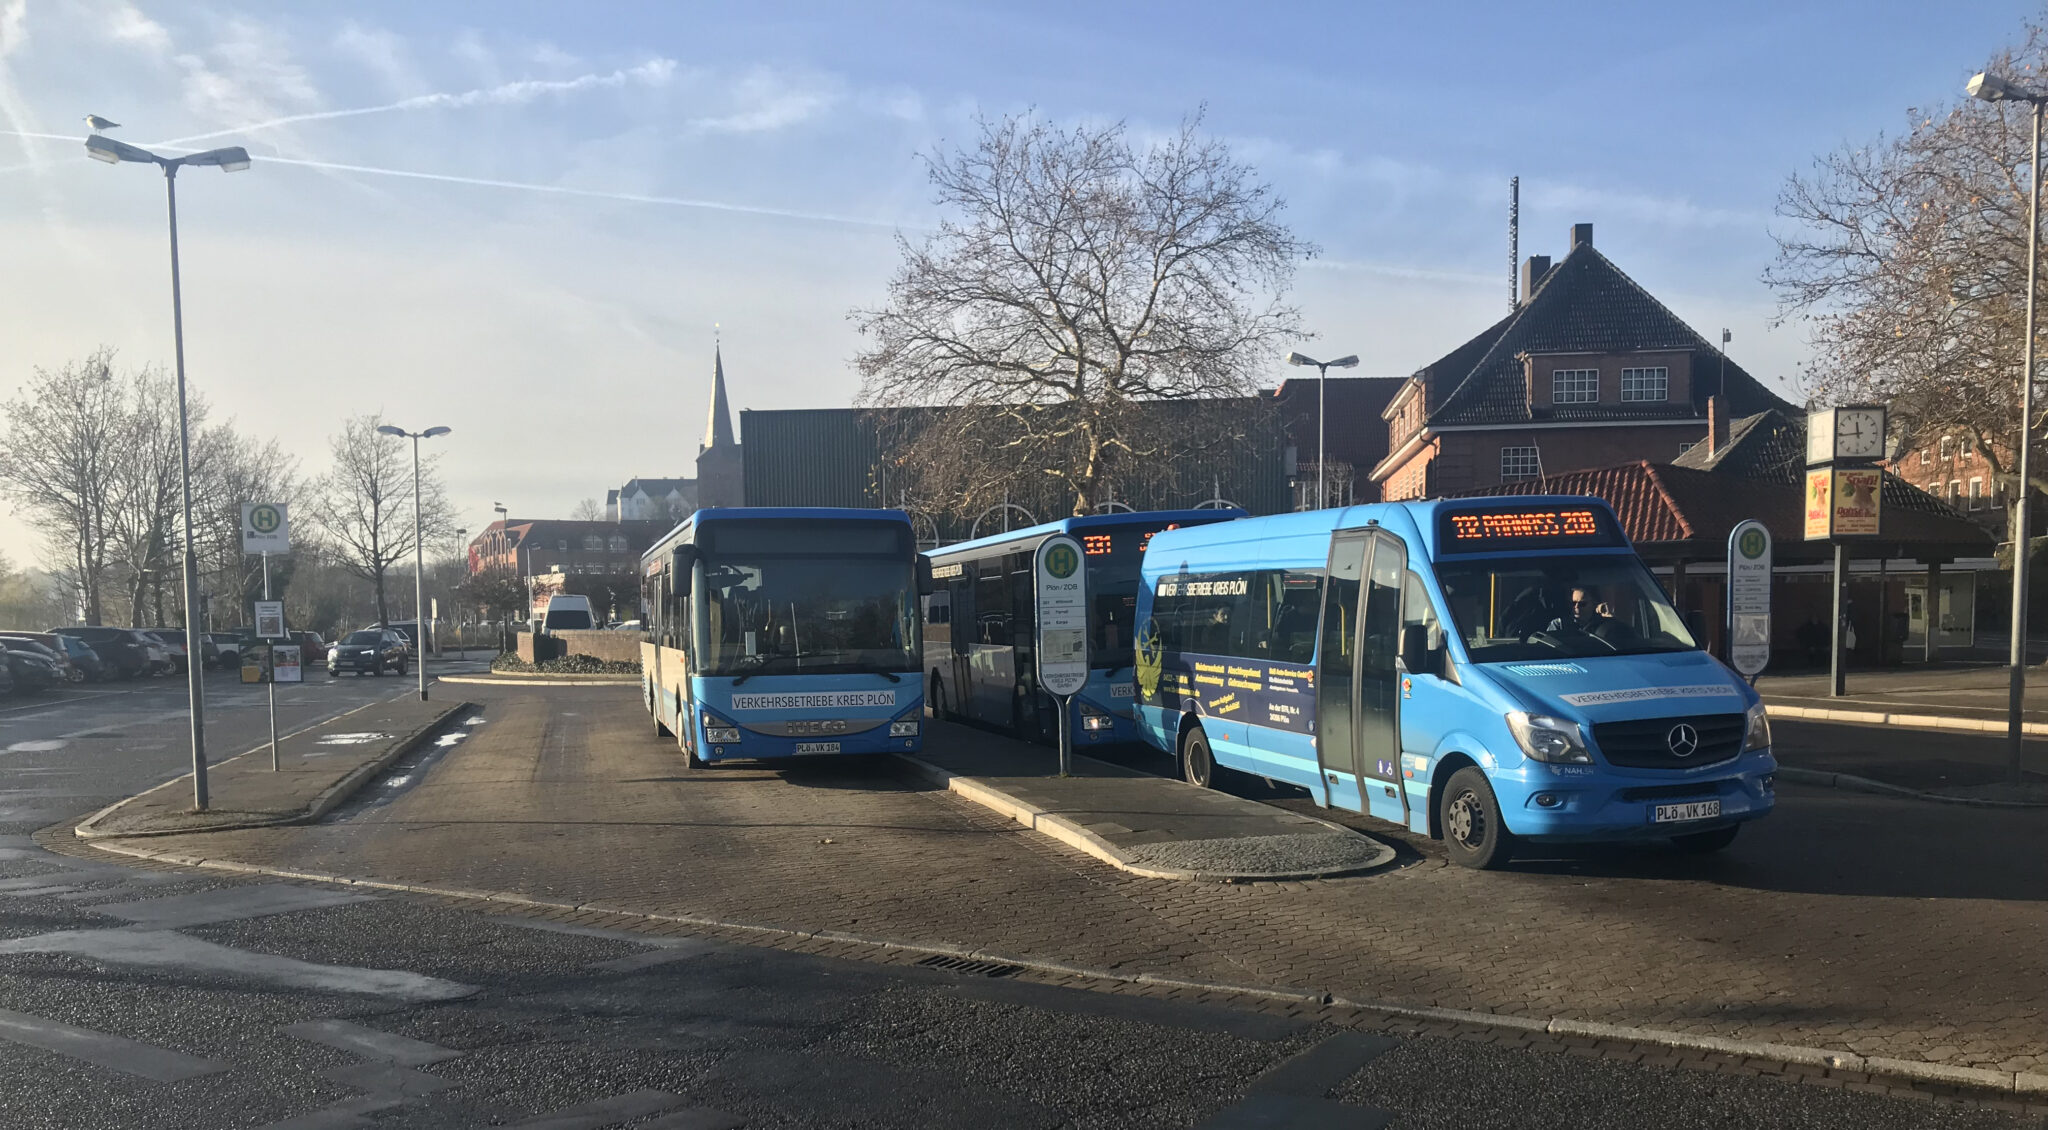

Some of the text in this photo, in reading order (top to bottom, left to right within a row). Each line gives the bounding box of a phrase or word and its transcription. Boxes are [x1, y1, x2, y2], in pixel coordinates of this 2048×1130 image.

[257, 510, 273, 527] H
[1452, 511, 1596, 538] 332 PARNASS ZOB
[1083, 535, 1111, 554] 331
[1746, 533, 1759, 553] H
[1054, 551, 1069, 570] H
[1229, 578, 1248, 595] PLÖN
[733, 691, 895, 709] VERKEHRSBETRIEBE KREIS PLÖN
[1572, 687, 1679, 703] VERKEHRSBETRIEBE
[787, 720, 847, 734] IVECO
[816, 743, 825, 752] VK
[826, 743, 840, 752] 184
[1657, 802, 1719, 820] PLÖ VK 168
